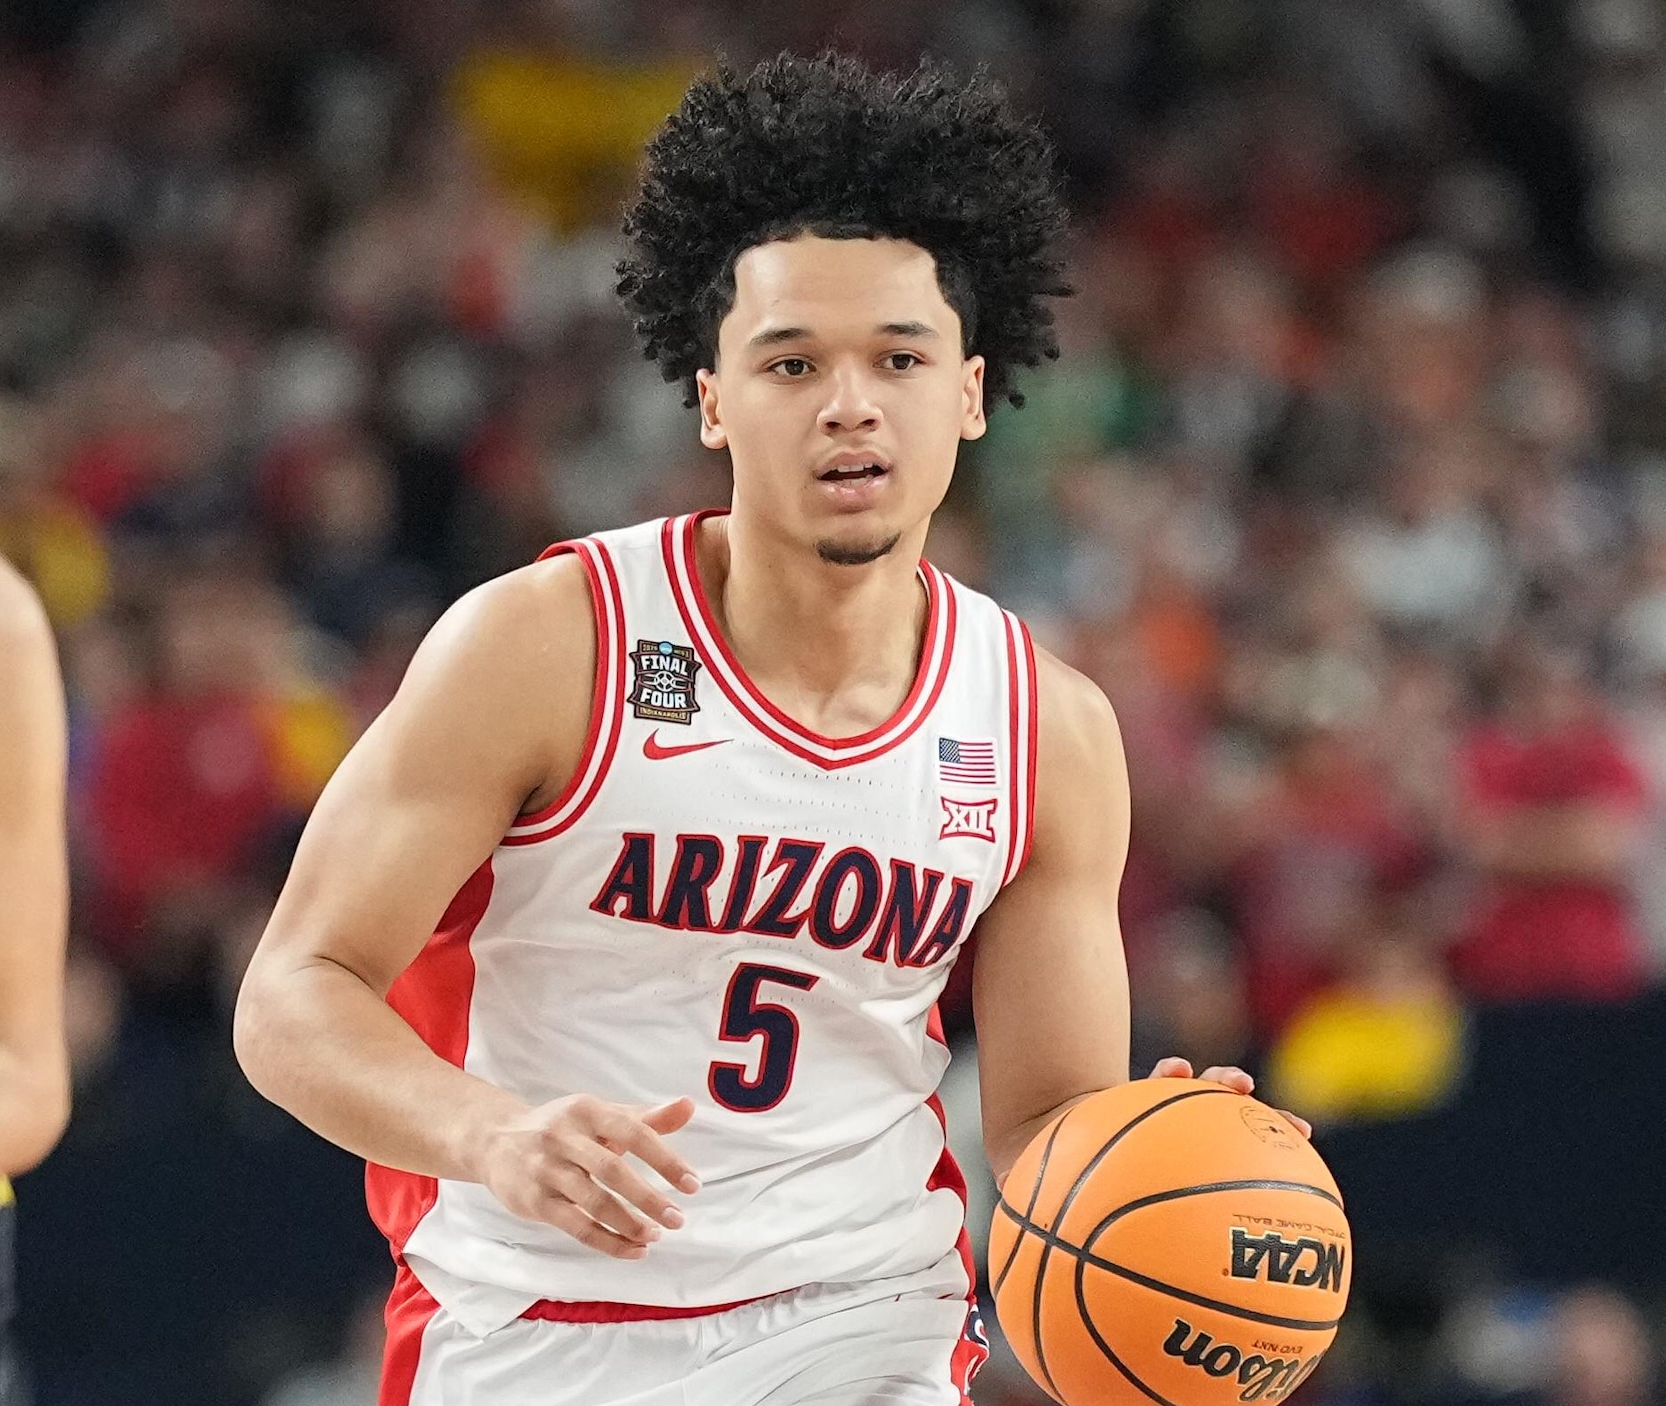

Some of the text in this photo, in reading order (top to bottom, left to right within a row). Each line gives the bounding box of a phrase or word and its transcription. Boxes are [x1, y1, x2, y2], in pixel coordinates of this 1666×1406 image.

[640, 654, 688, 676] FINAL
[640, 687, 687, 708] FOUR
[639, 707, 687, 719] INDIANAPOLIS
[589, 832, 973, 968] ARIZONA
[707, 962, 820, 1114] 5
[1232, 1213, 1273, 1227] BALL
[1275, 1218, 1313, 1231] GAME
[1230, 1228, 1345, 1294] NCAA
